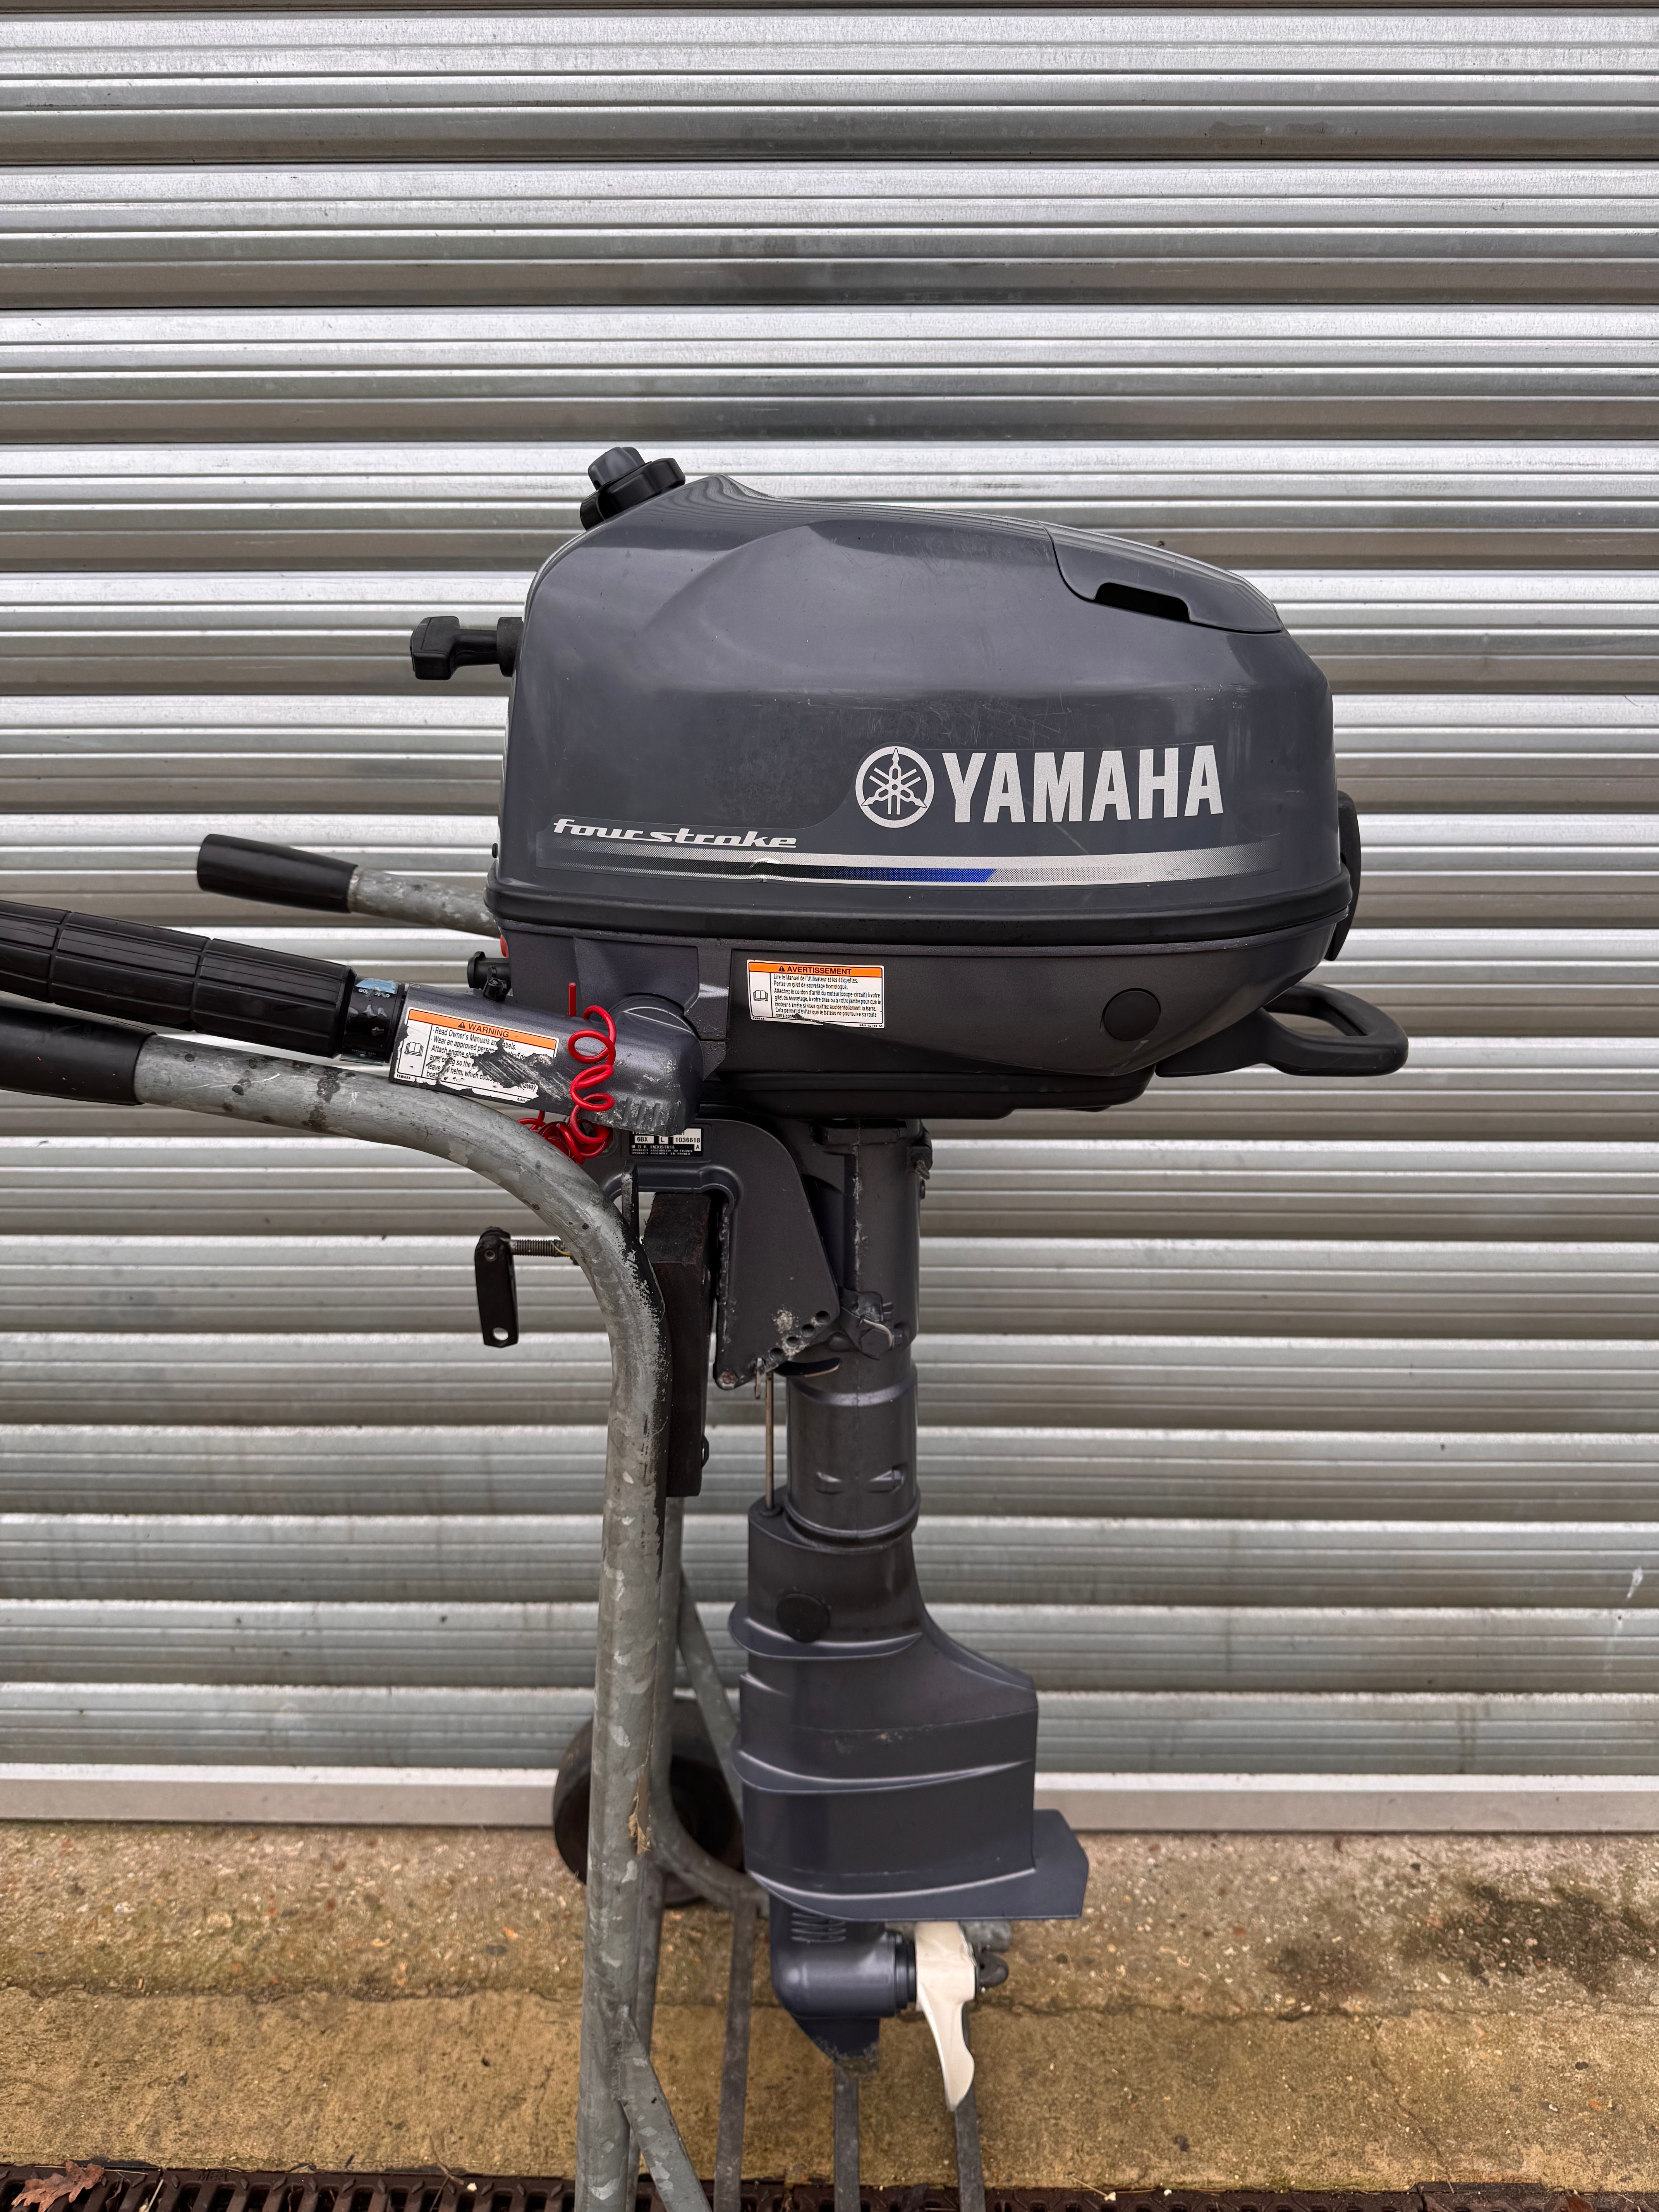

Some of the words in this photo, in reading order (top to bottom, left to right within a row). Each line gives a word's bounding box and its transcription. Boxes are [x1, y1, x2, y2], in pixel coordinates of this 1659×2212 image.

[942, 745, 1223, 823] YAMAHA
[787, 966, 852, 974] AVERTISSEMENT
[435, 1027, 448, 1036] Read
[449, 1030, 468, 1040] Owner's
[469, 1034, 489, 1044] Manuals
[469, 1023, 509, 1037] WARNING
[431, 1045, 447, 1054] Attach
[434, 1035, 447, 1044] Wear
[454, 1041, 477, 1050] approved
